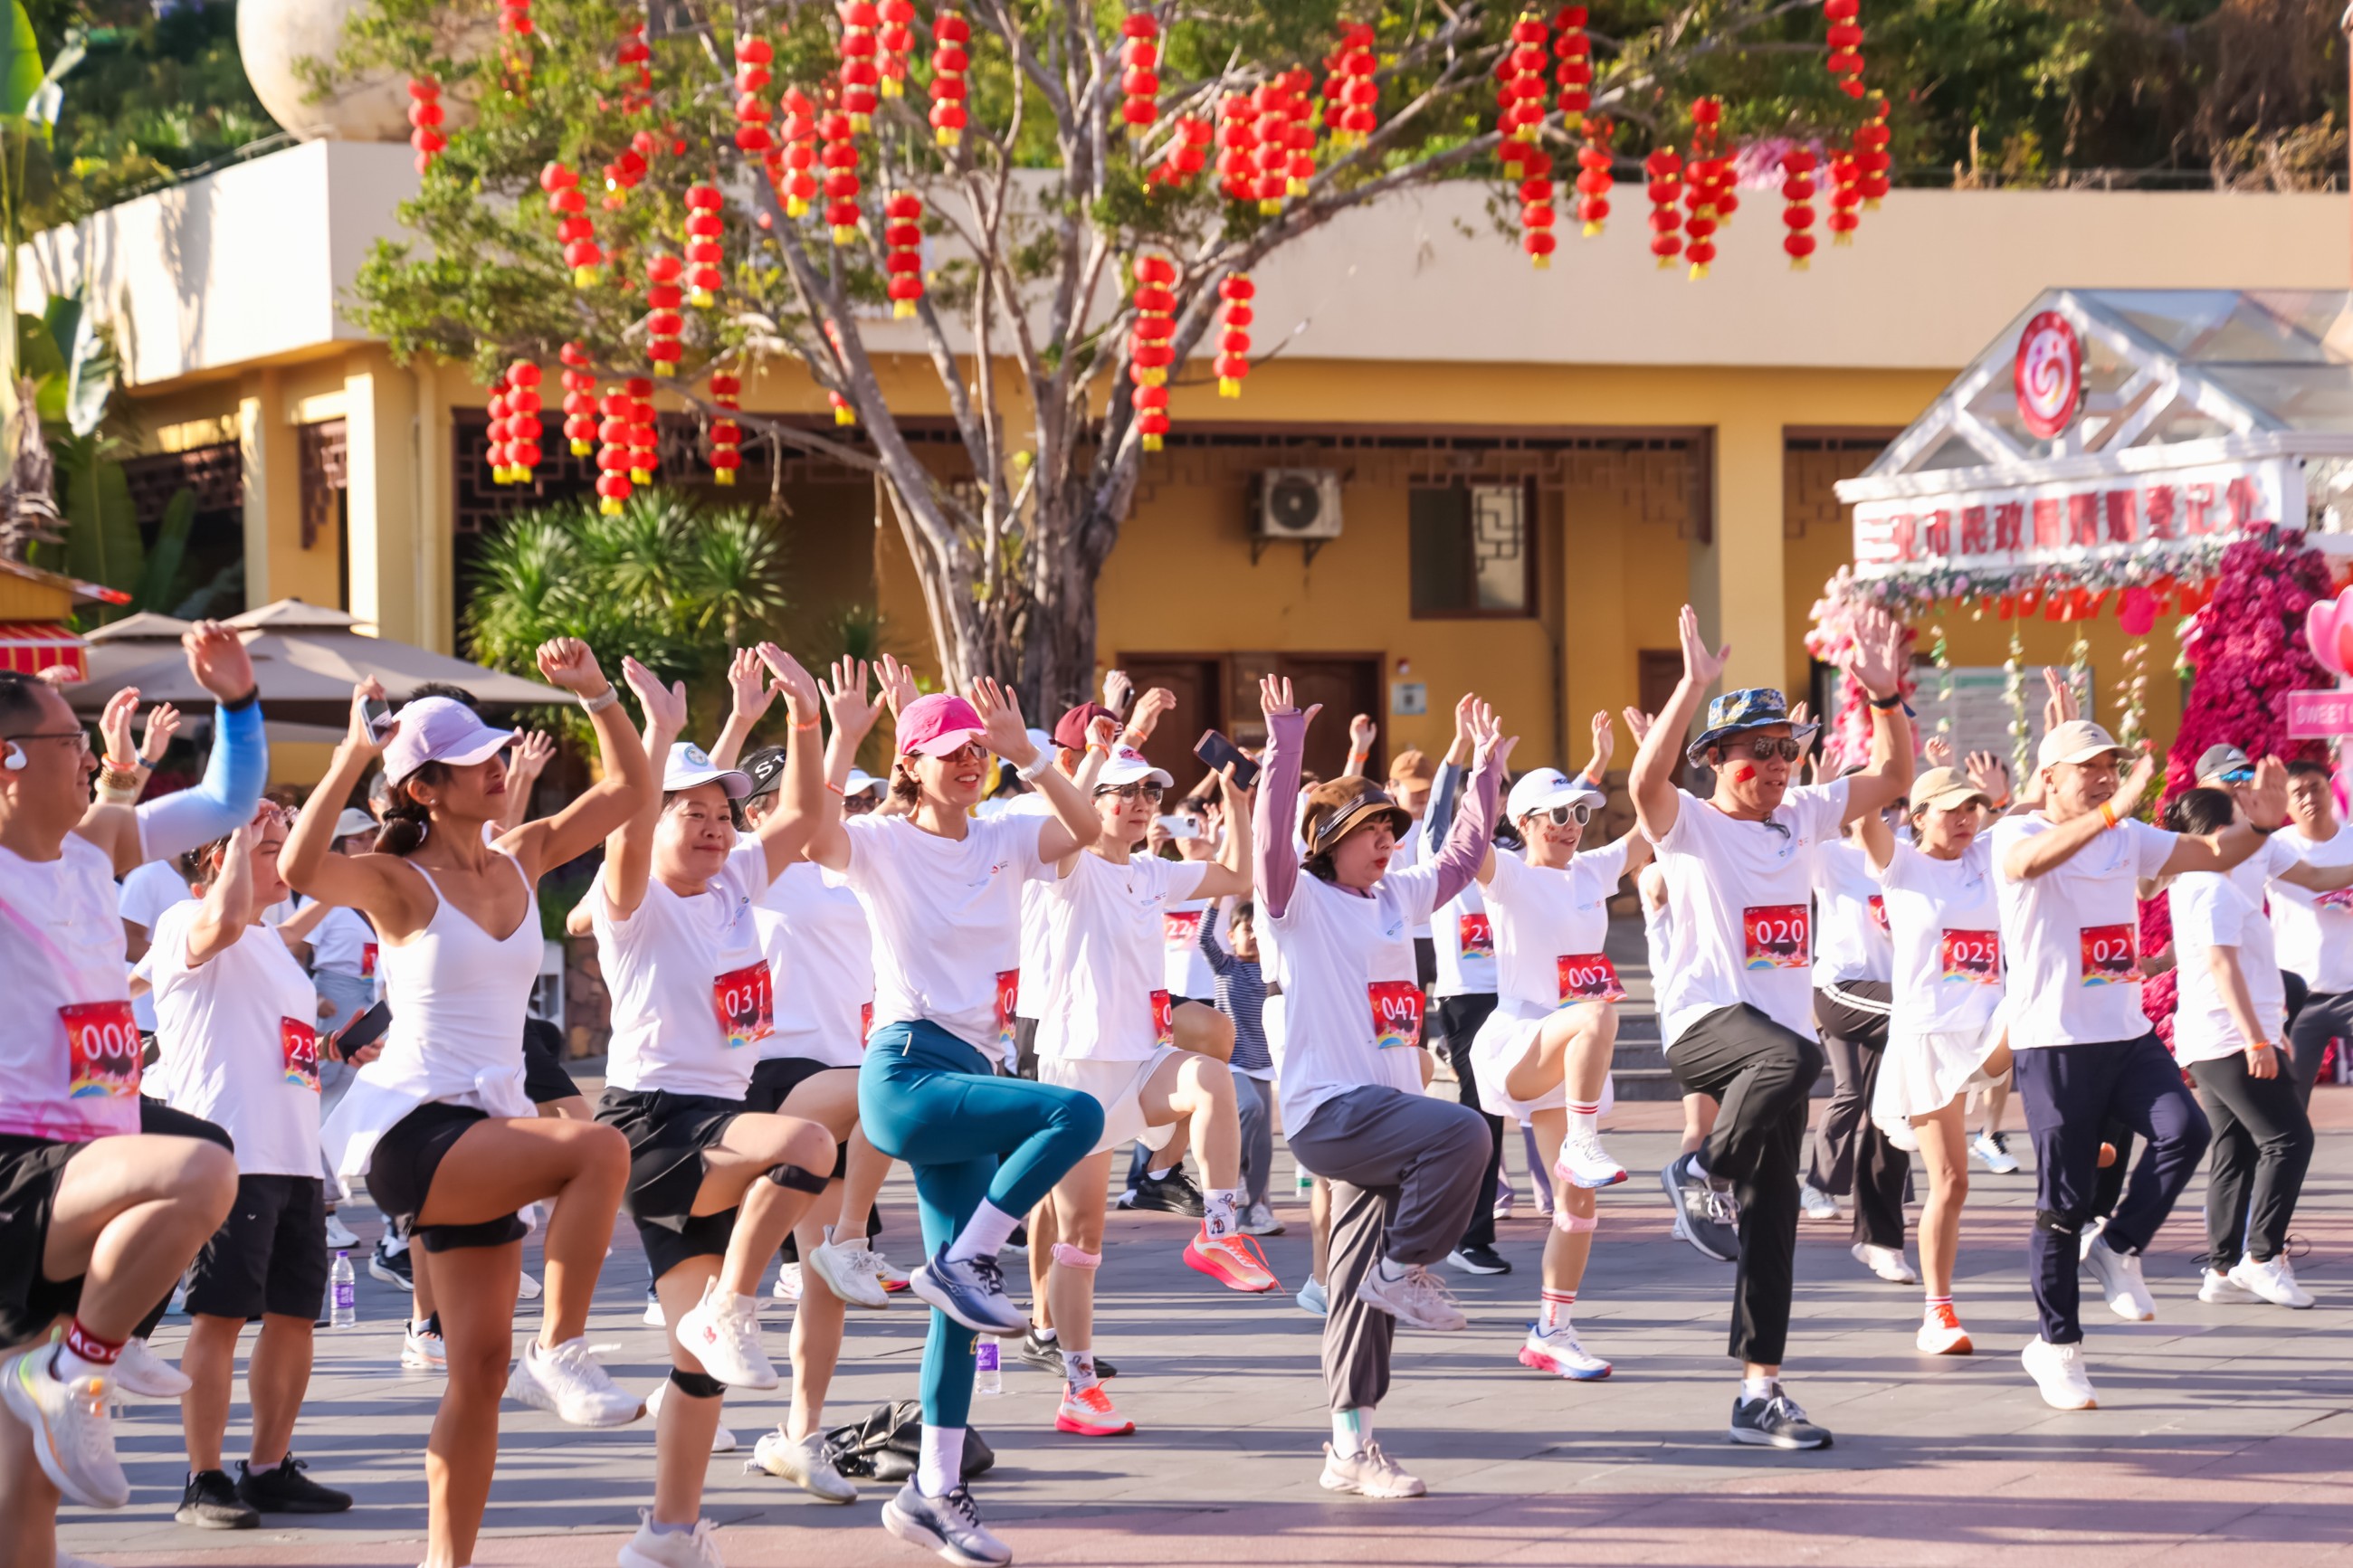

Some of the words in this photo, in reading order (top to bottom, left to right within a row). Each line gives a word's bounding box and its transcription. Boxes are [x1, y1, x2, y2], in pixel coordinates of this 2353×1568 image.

[2296, 703, 2347, 726] SWEET
[1756, 919, 1805, 944] 020
[1953, 940, 1996, 964] 025
[2093, 938, 2128, 962] 02
[1568, 965, 1612, 989] 002
[725, 981, 765, 1019] 031
[1382, 995, 1418, 1022] 042
[81, 1022, 138, 1061] 008
[291, 1034, 318, 1066] 23
